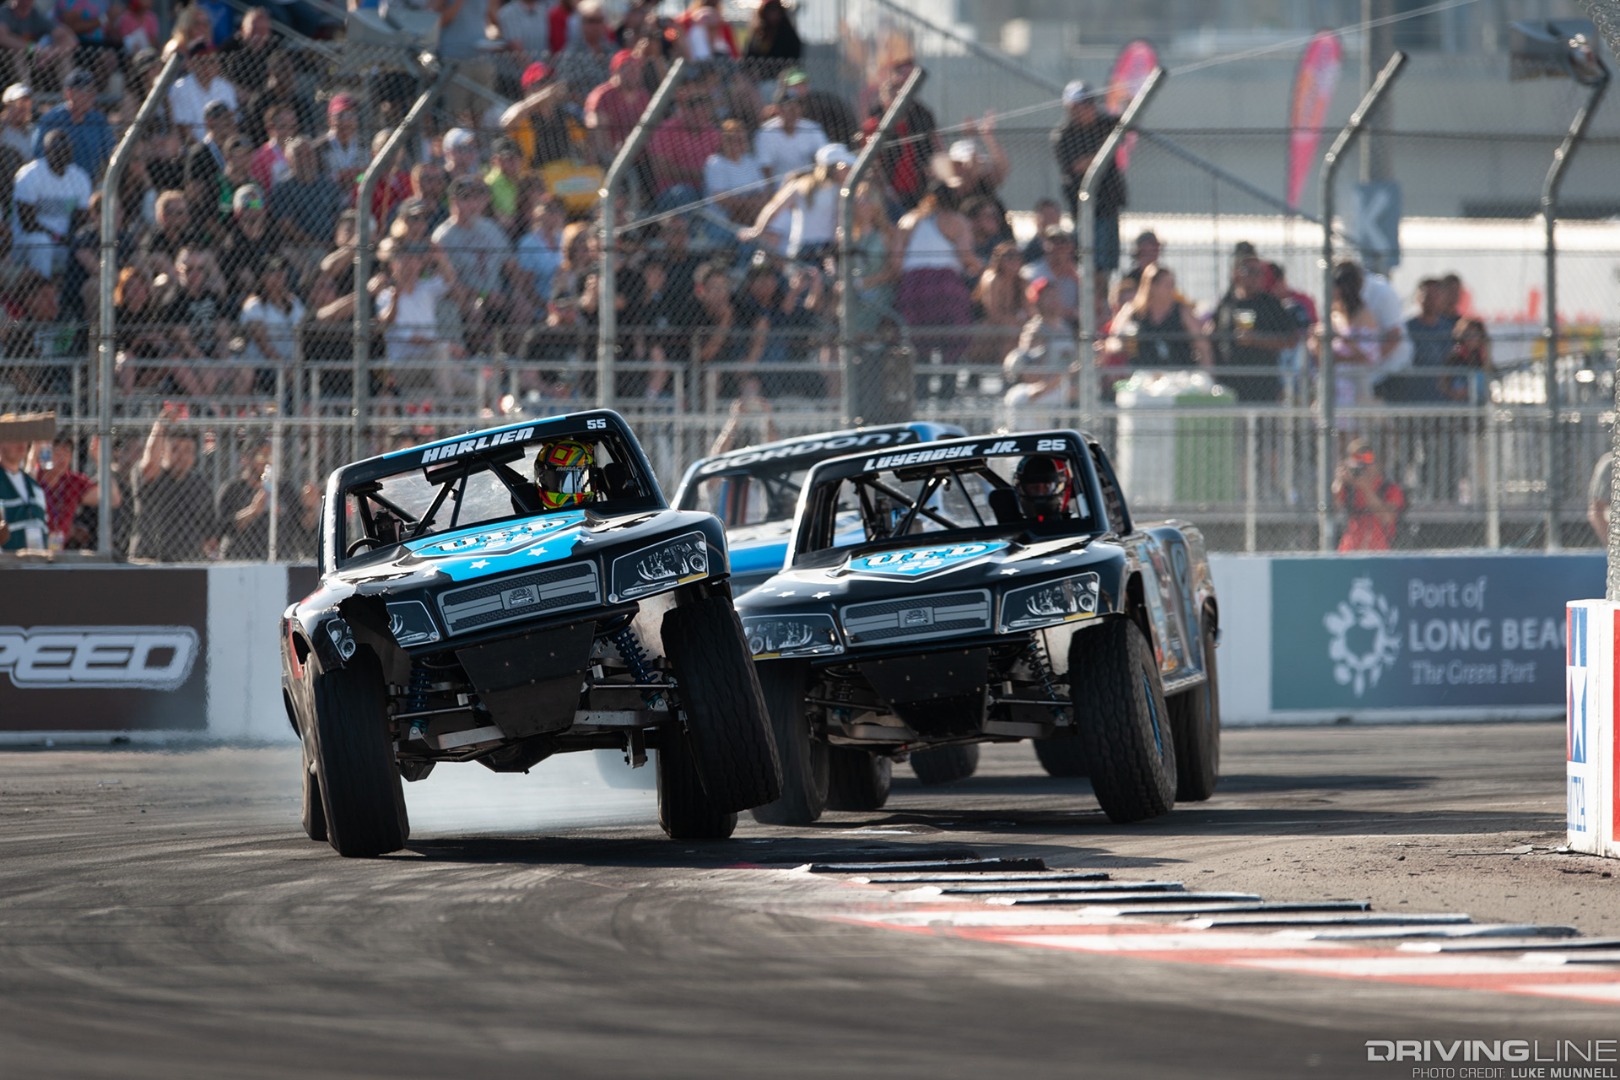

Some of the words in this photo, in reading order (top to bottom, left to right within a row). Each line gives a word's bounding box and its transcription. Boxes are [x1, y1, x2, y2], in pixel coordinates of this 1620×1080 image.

[421, 426, 535, 464] HARLIEN
[586, 418, 607, 430] 55
[701, 432, 892, 475] GORDON
[863, 443, 979, 472] LUYENDYK
[983, 440, 1021, 455] JR.
[1036, 439, 1067, 452] 25
[1408, 577, 1457, 608] Port
[1461, 575, 1488, 612] of
[1408, 618, 1492, 652] LONG
[1411, 660, 1445, 686] The
[1446, 659, 1498, 686] Green
[1500, 658, 1537, 685] Port
